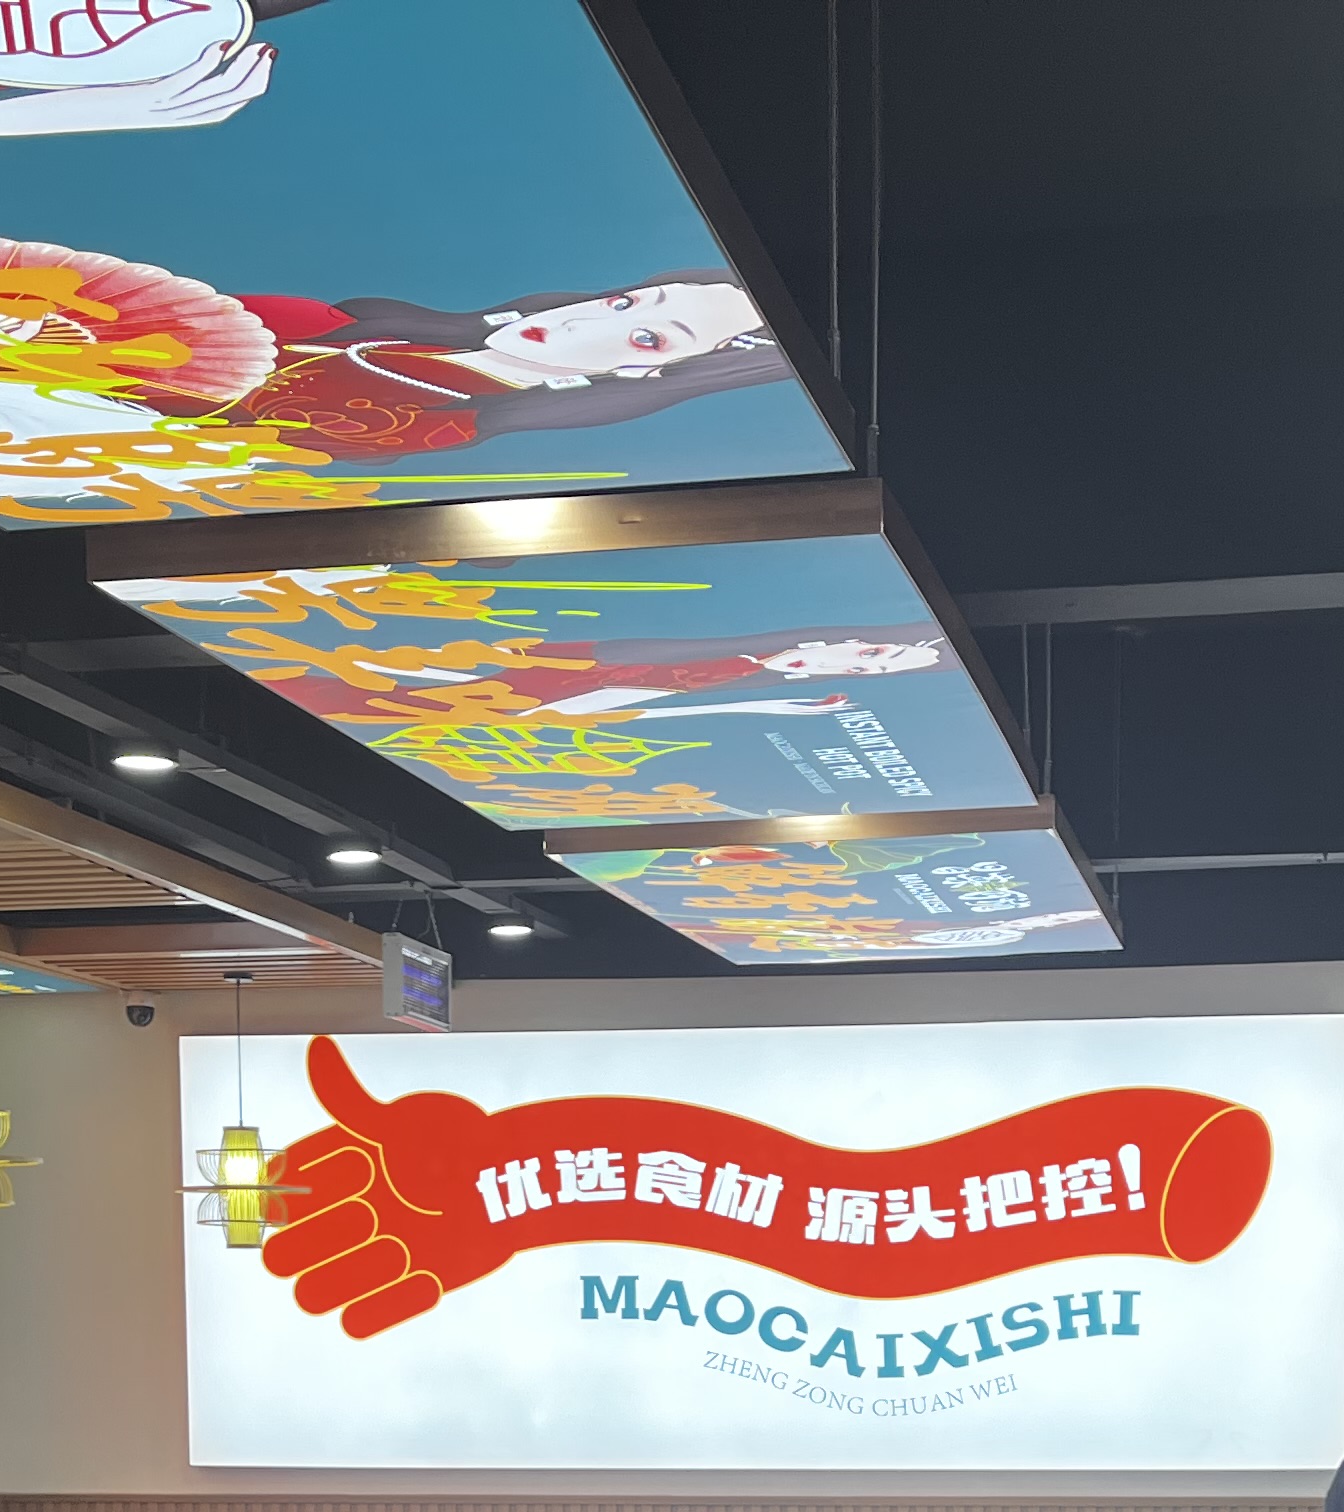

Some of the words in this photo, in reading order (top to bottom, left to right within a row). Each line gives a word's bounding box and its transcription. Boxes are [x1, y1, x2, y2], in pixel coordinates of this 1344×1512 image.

[834, 710, 896, 749] INSTANT
[812, 747, 859, 765] HOT
[828, 764, 872, 780] POT
[864, 749, 917, 778] BOILED
[887, 777, 933, 797] SPICY
[475, 1148, 785, 1228] 优选食材
[579, 1274, 1142, 1379] MAOCAIXISHI
[702, 1349, 788, 1392] ZHENG
[792, 1379, 866, 1417] ZONG
[870, 1390, 964, 1418] CHUAN
[967, 1373, 1018, 1405] WEI
